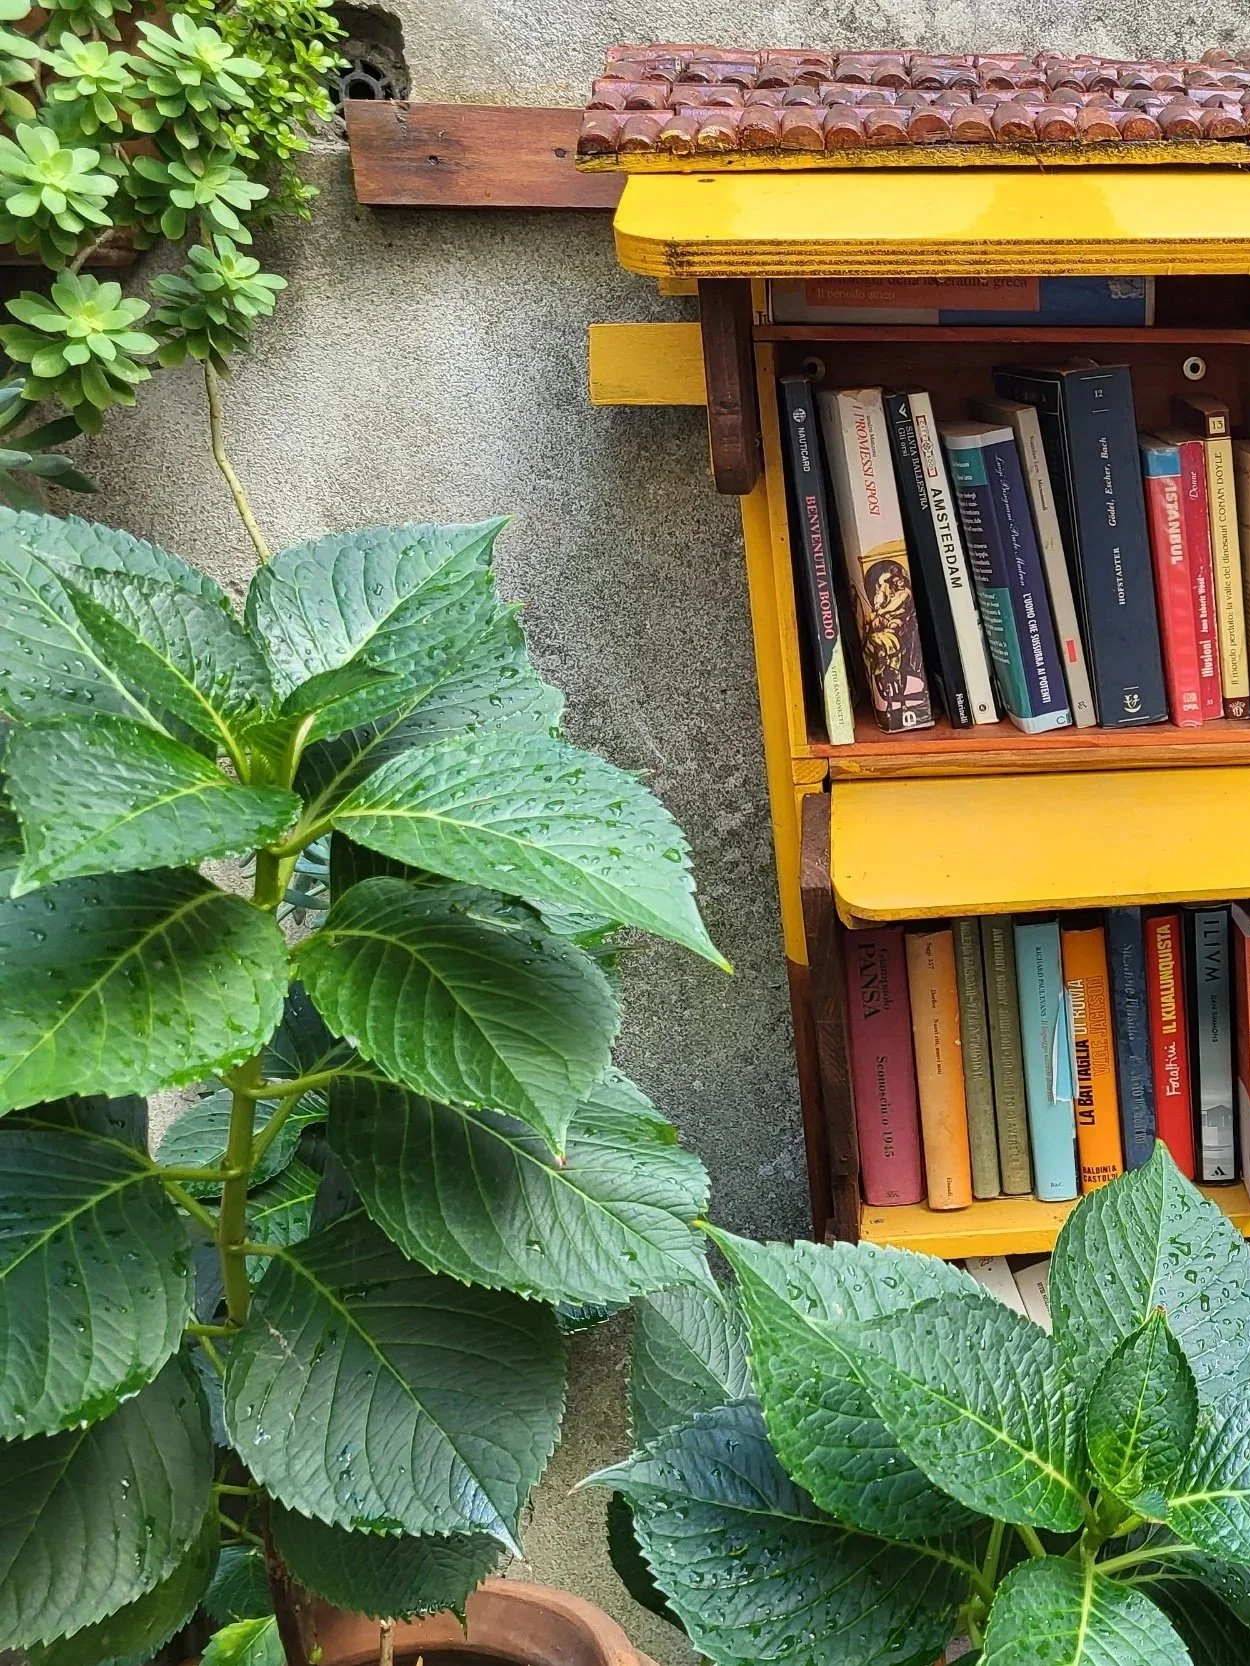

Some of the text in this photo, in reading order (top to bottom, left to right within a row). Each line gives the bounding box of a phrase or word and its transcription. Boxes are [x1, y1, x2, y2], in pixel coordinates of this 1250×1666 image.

[1094, 389, 1104, 398] 12
[895, 426, 909, 458] Gli orsi
[1212, 420, 1223, 430] 13
[796, 426, 812, 473] NAUTICARD
[851, 403, 881, 517] I PROMESSI SPOSI
[903, 424, 929, 511] SILVIA BALLESTRA
[1212, 450, 1224, 485] DOYLE
[1097, 435, 1118, 527] Gödel, Escher, Bach
[1185, 469, 1200, 501] Donne
[1215, 486, 1228, 522] CONAN
[929, 485, 963, 590] AMSTERDAM
[1160, 485, 1187, 565] ISTANBUL
[1218, 523, 1231, 564] dinosauri
[803, 493, 836, 641] BENVENUTI A BORDO
[1110, 545, 1127, 605] HOFSTADTER
[1222, 580, 1233, 601] valle
[1224, 600, 1234, 611] la
[1225, 610, 1239, 647] perduto:
[1021, 592, 1052, 705] L'UOMO CHE SUSSURRA AI POTENTI
[1227, 647, 1240, 678] mondo
[829, 665, 846, 726] VITO SANSONETTI
[953, 691, 969, 725] Feltrinelli
[853, 940, 886, 1021] PANSA
[874, 946, 896, 1011] Giampaolo
[1153, 923, 1182, 1097] Forattini IL KUALUNQUISTA
